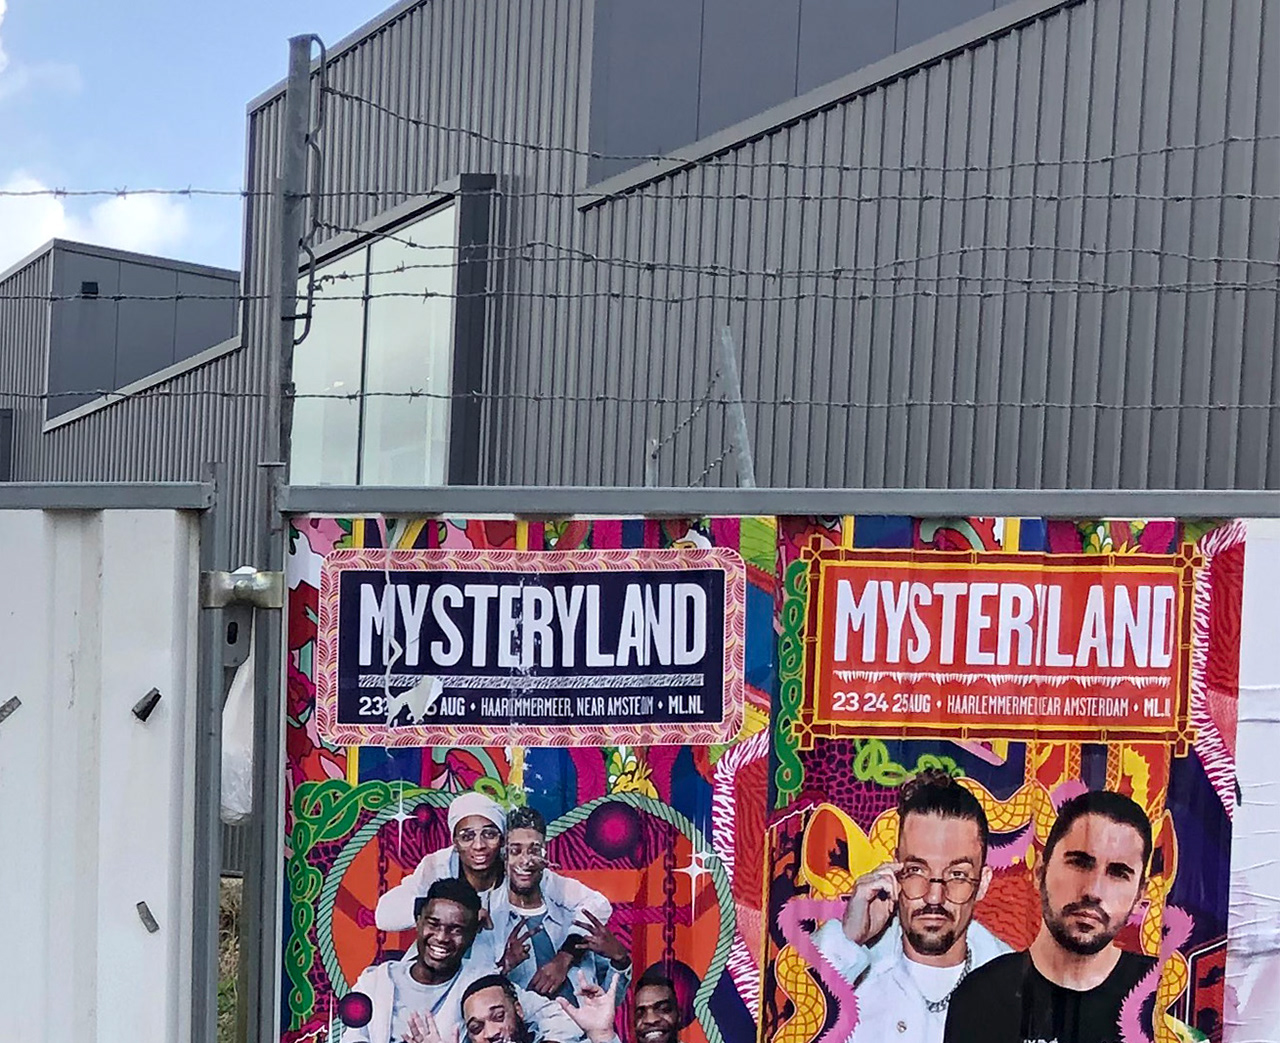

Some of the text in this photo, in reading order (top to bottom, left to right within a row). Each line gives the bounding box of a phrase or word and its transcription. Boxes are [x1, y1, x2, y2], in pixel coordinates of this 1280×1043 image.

[359, 583, 708, 668] MYSTERYLAND
[833, 579, 1175, 668] MYSTERYLAND
[359, 696, 384, 716] 23
[440, 697, 465, 716] AUG
[481, 697, 574, 717] HAARMMERMEER,
[577, 697, 605, 716] NEAR
[607, 696, 654, 716] AMSTEM
[668, 695, 704, 714] ML.NL
[832, 691, 859, 711] 23
[863, 692, 889, 712] 24
[892, 693, 909, 712] 25
[909, 694, 931, 713] AUG
[947, 695, 1039, 716] HAARLEMMERME
[1039, 696, 1061, 716] EAR
[1064, 697, 1129, 717] AMSTERDAM
